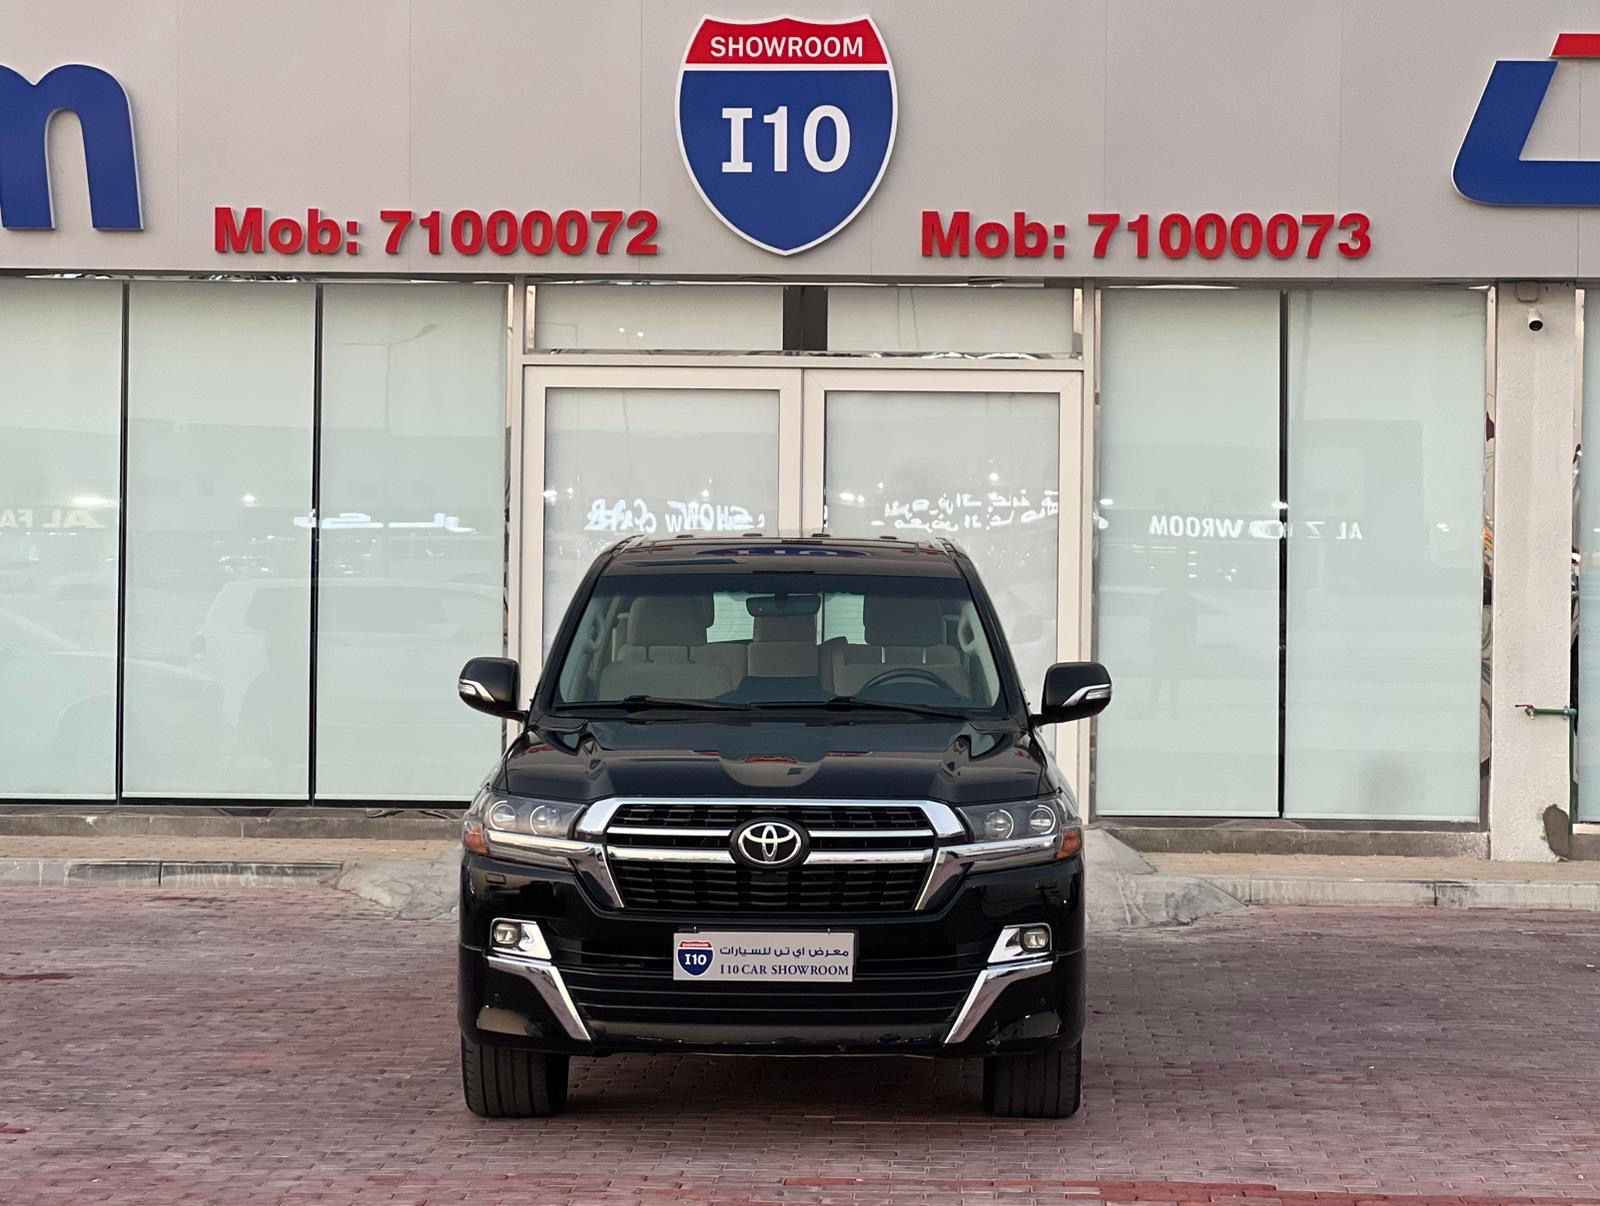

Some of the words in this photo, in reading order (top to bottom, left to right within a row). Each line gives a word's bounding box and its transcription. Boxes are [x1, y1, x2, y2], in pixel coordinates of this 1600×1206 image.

[710, 36, 864, 58] SHOWROOM
[721, 104, 851, 173] I10
[214, 207, 359, 254] Mob:
[379, 209, 659, 255] 71000072
[921, 210, 1066, 257] Mob:
[1087, 212, 1372, 259] 71000073
[684, 953, 707, 965] I10
[719, 946, 771, 957] للسيارات
[808, 947, 849, 957] معرض
[741, 964, 767, 975] CAR
[771, 965, 849, 976] SHOWROOM
